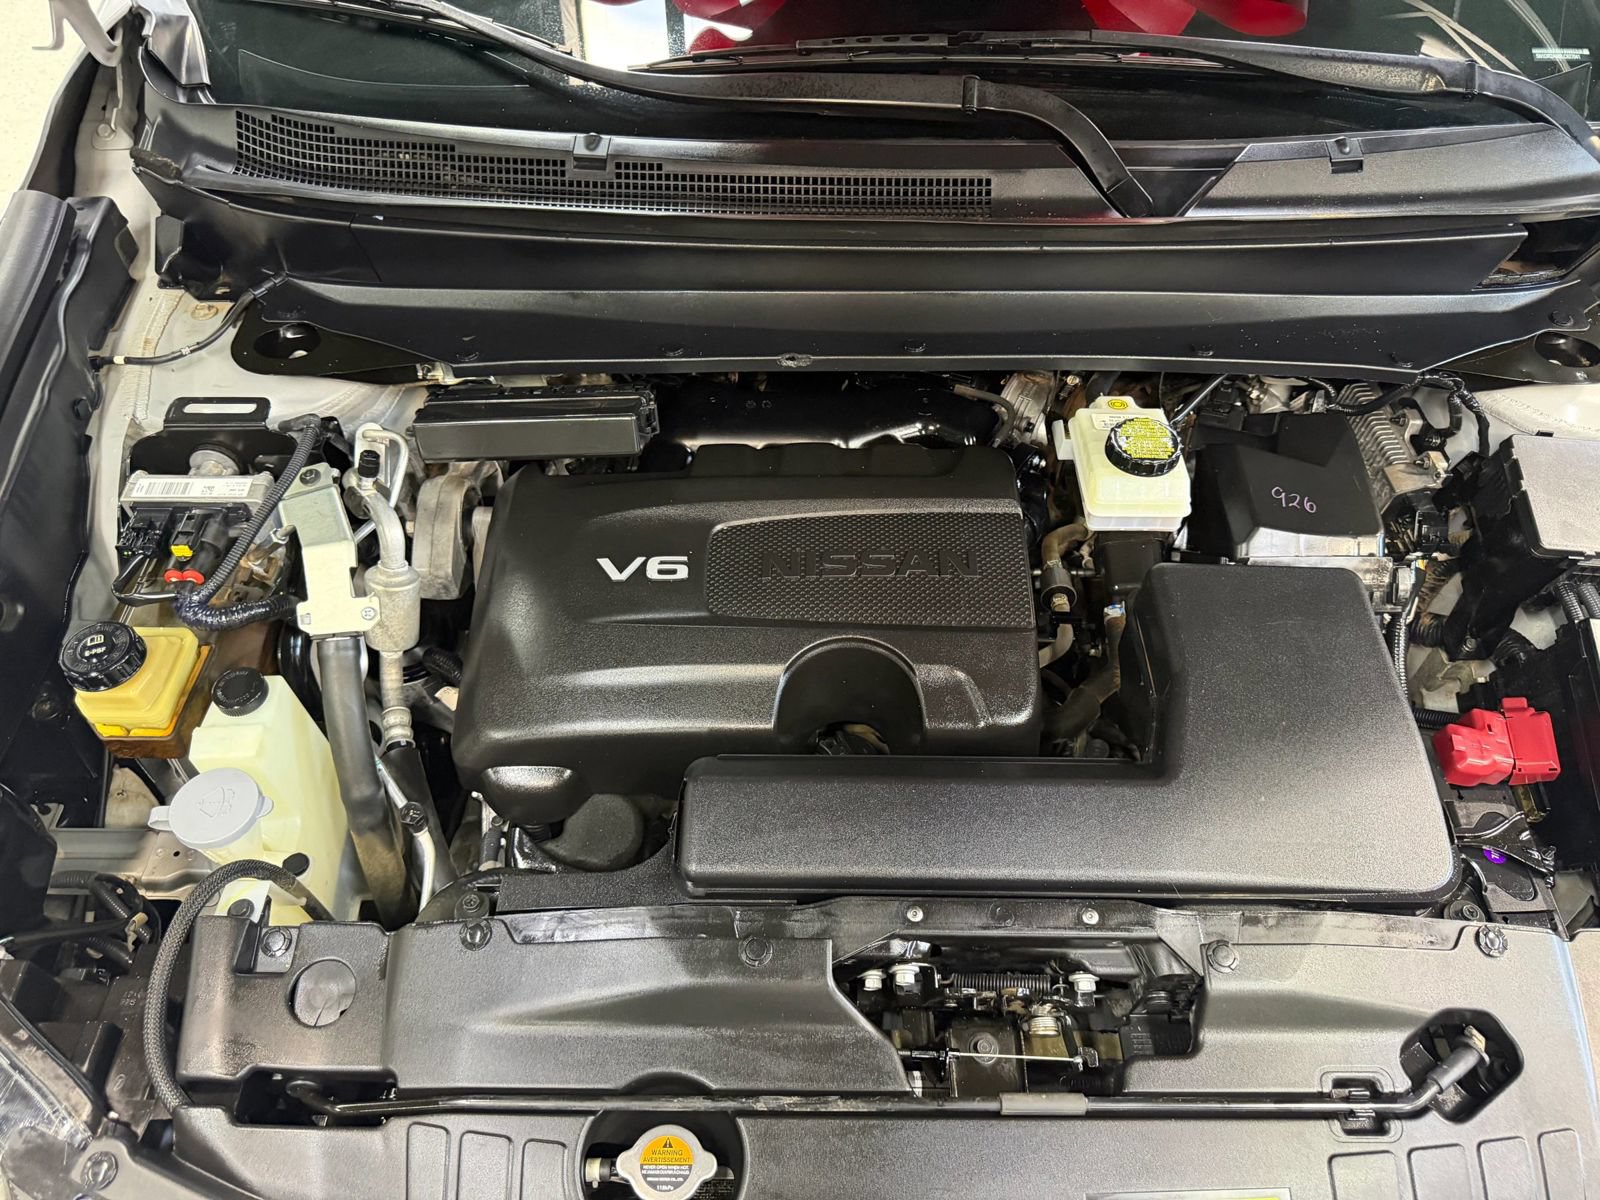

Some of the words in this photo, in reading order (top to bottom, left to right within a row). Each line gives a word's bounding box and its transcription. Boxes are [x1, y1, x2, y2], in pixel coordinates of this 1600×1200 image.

[1271, 486, 1317, 513] 926
[596, 556, 689, 582] V6
[761, 550, 980, 579] NISSAN
